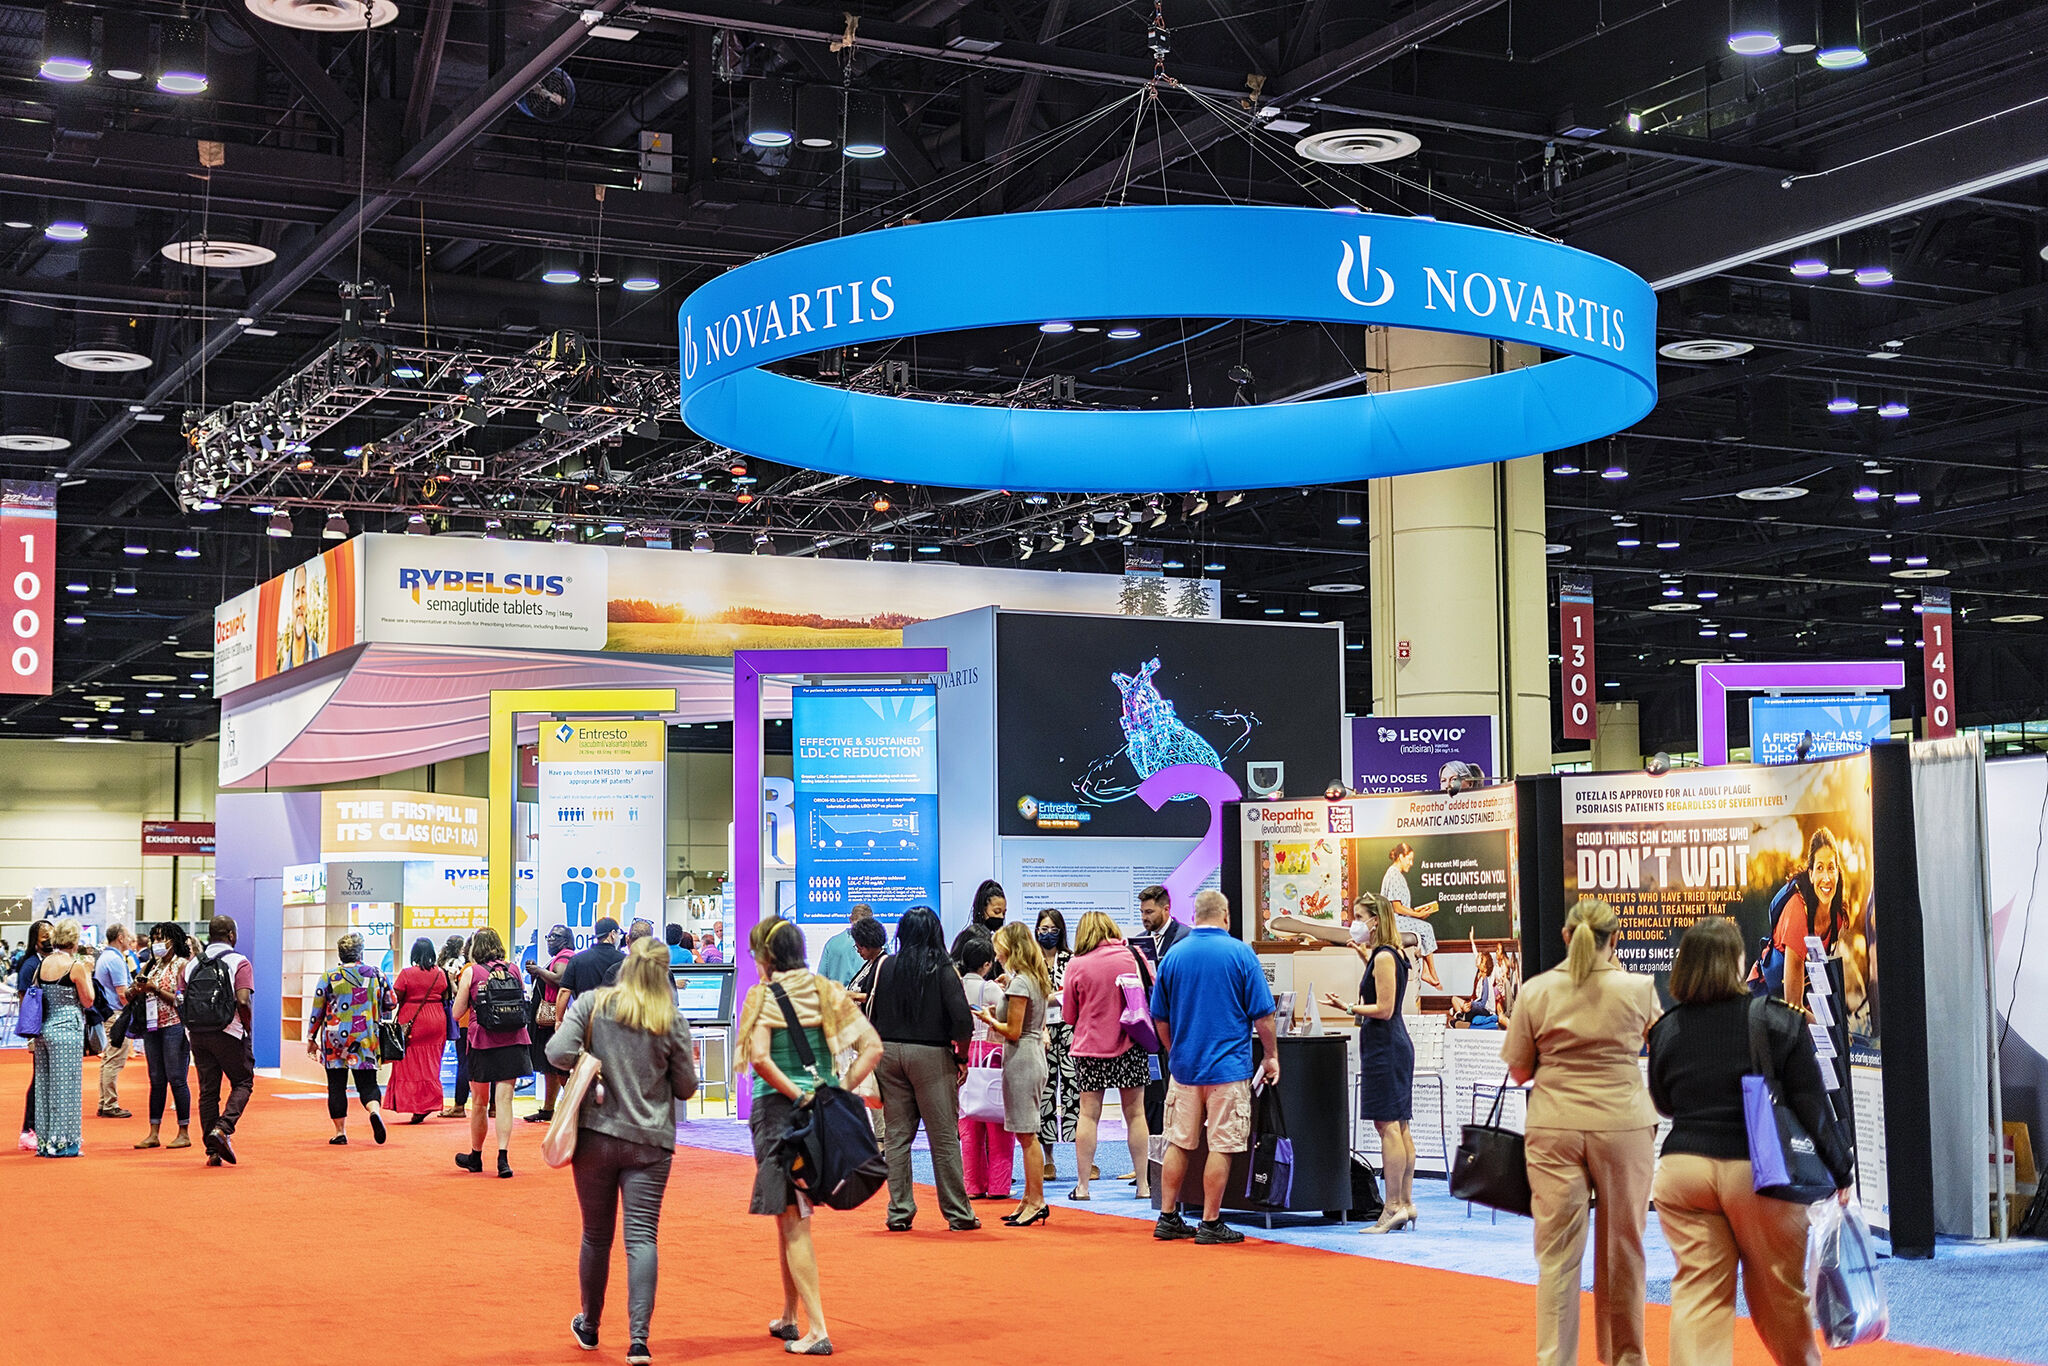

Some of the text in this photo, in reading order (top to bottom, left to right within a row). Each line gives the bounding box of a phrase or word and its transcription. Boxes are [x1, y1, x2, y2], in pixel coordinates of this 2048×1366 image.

[1422, 267, 1625, 351] NOVARTIS
[704, 276, 895, 366] NOVARTIS
[12, 534, 41, 676] 1000
[426, 597, 500, 616] semaglutide
[503, 601, 543, 616] tablets
[545, 609, 556, 618] 7mg
[1571, 616, 1588, 726] 1300
[1931, 625, 1949, 727] 1400
[579, 728, 628, 740] Entresto
[1762, 731, 1863, 744] A FIRSTN-CLASS
[631, 740, 648, 748] tablets
[799, 736, 921, 746] EFFECTIVE & SUSTAINED
[800, 748, 840, 758] LDL-C
[1400, 744, 1434, 754] (inclisiran)
[1810, 742, 1864, 753] OWERING
[1361, 774, 1428, 784] TWO DOSES
[1576, 784, 1752, 802] OTEZLA IS APPROVED FOR ALL ADULT PLAQUE
[1448, 800, 1470, 810] added
[1482, 796, 1498, 808] statin
[1576, 796, 1784, 814] PSORIASIS PATIENTS REGARDLESS OF SEVERITY LEVEL
[336, 801, 478, 824] THE FIRST PILL IN
[1262, 807, 1314, 824] Repatha
[1330, 806, 1351, 816] They
[1330, 820, 1352, 832] You
[1396, 816, 1442, 828] DRAMATIC
[1443, 814, 1460, 826] AND
[1460, 812, 1495, 824] SUSTAINED
[1262, 822, 1302, 834] (evolocumab)
[145, 836, 216, 844] EXHIBITOR LOUN
[336, 823, 478, 848] ITS CLASS (GLP-1 RA)
[1576, 826, 1749, 846] GOOD THINGS CAN COME TO THOSE WHO
[1421, 860, 1429, 869] As
[1680, 845, 1750, 888] WAIT
[444, 869, 534, 887] RYBEUS
[1421, 873, 1442, 887] SHE
[1444, 871, 1480, 886] COUNTS
[1480, 870, 1491, 884] ON
[1438, 892, 1464, 902] Because
[1464, 891, 1478, 900] each
[1478, 890, 1488, 900] and
[1578, 891, 1744, 903] FOR PATIENTS WHO HAVE TRIED TOPICALS,
[44, 892, 96, 919] AANP
[1456, 904, 1462, 915] of
[1463, 903, 1477, 912] them
[1478, 904, 1491, 912] count
[1622, 906, 1635, 916] AN
[1637, 906, 1659, 915] ORAL
[1662, 904, 1706, 915] TREATMENT
[1707, 903, 1726, 914] THAT
[412, 908, 470, 918] THE FIRST
[412, 918, 468, 928] ITS CLASS
[1618, 917, 1672, 928] YSTEMICALLY
[1674, 916, 1694, 926] FROM
[1618, 930, 1625, 940] A
[1648, 948, 1674, 959] SINCE
[1629, 964, 1638, 972] an
[1640, 962, 1673, 973] expanded
